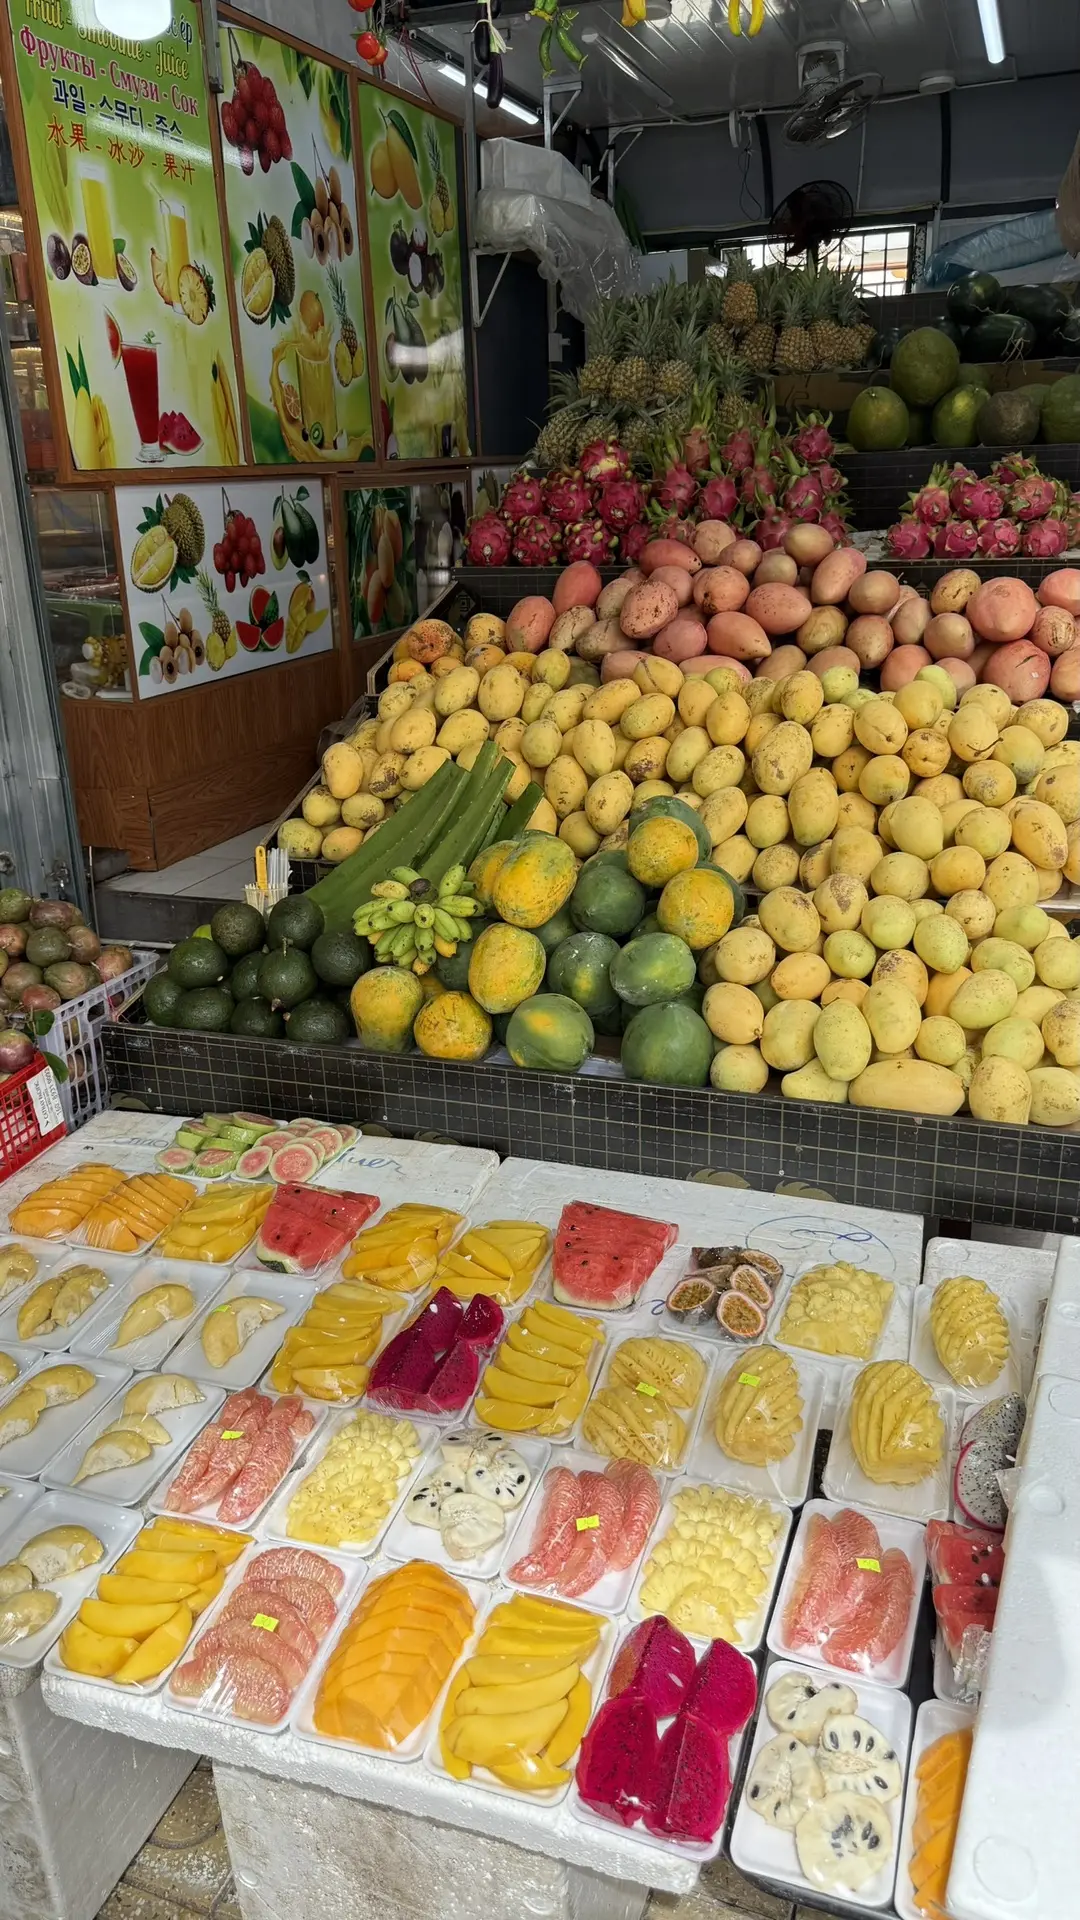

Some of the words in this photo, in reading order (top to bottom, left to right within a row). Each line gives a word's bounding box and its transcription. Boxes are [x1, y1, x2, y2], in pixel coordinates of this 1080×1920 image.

[155, 40, 190, 80] Juice
[180, 13, 193, 54] ép
[20, 25, 97, 79] Фрукты
[109, 60, 160, 102] Смузи
[171, 84, 199, 118] Сок
[52, 78, 87, 115] 과일
[99, 95, 144, 133] 스무디
[155, 113, 184, 144] 주스
[47, 115, 90, 153] 水果
[107, 136, 145, 168] 冰沙
[163, 152, 196, 185] 果汁
